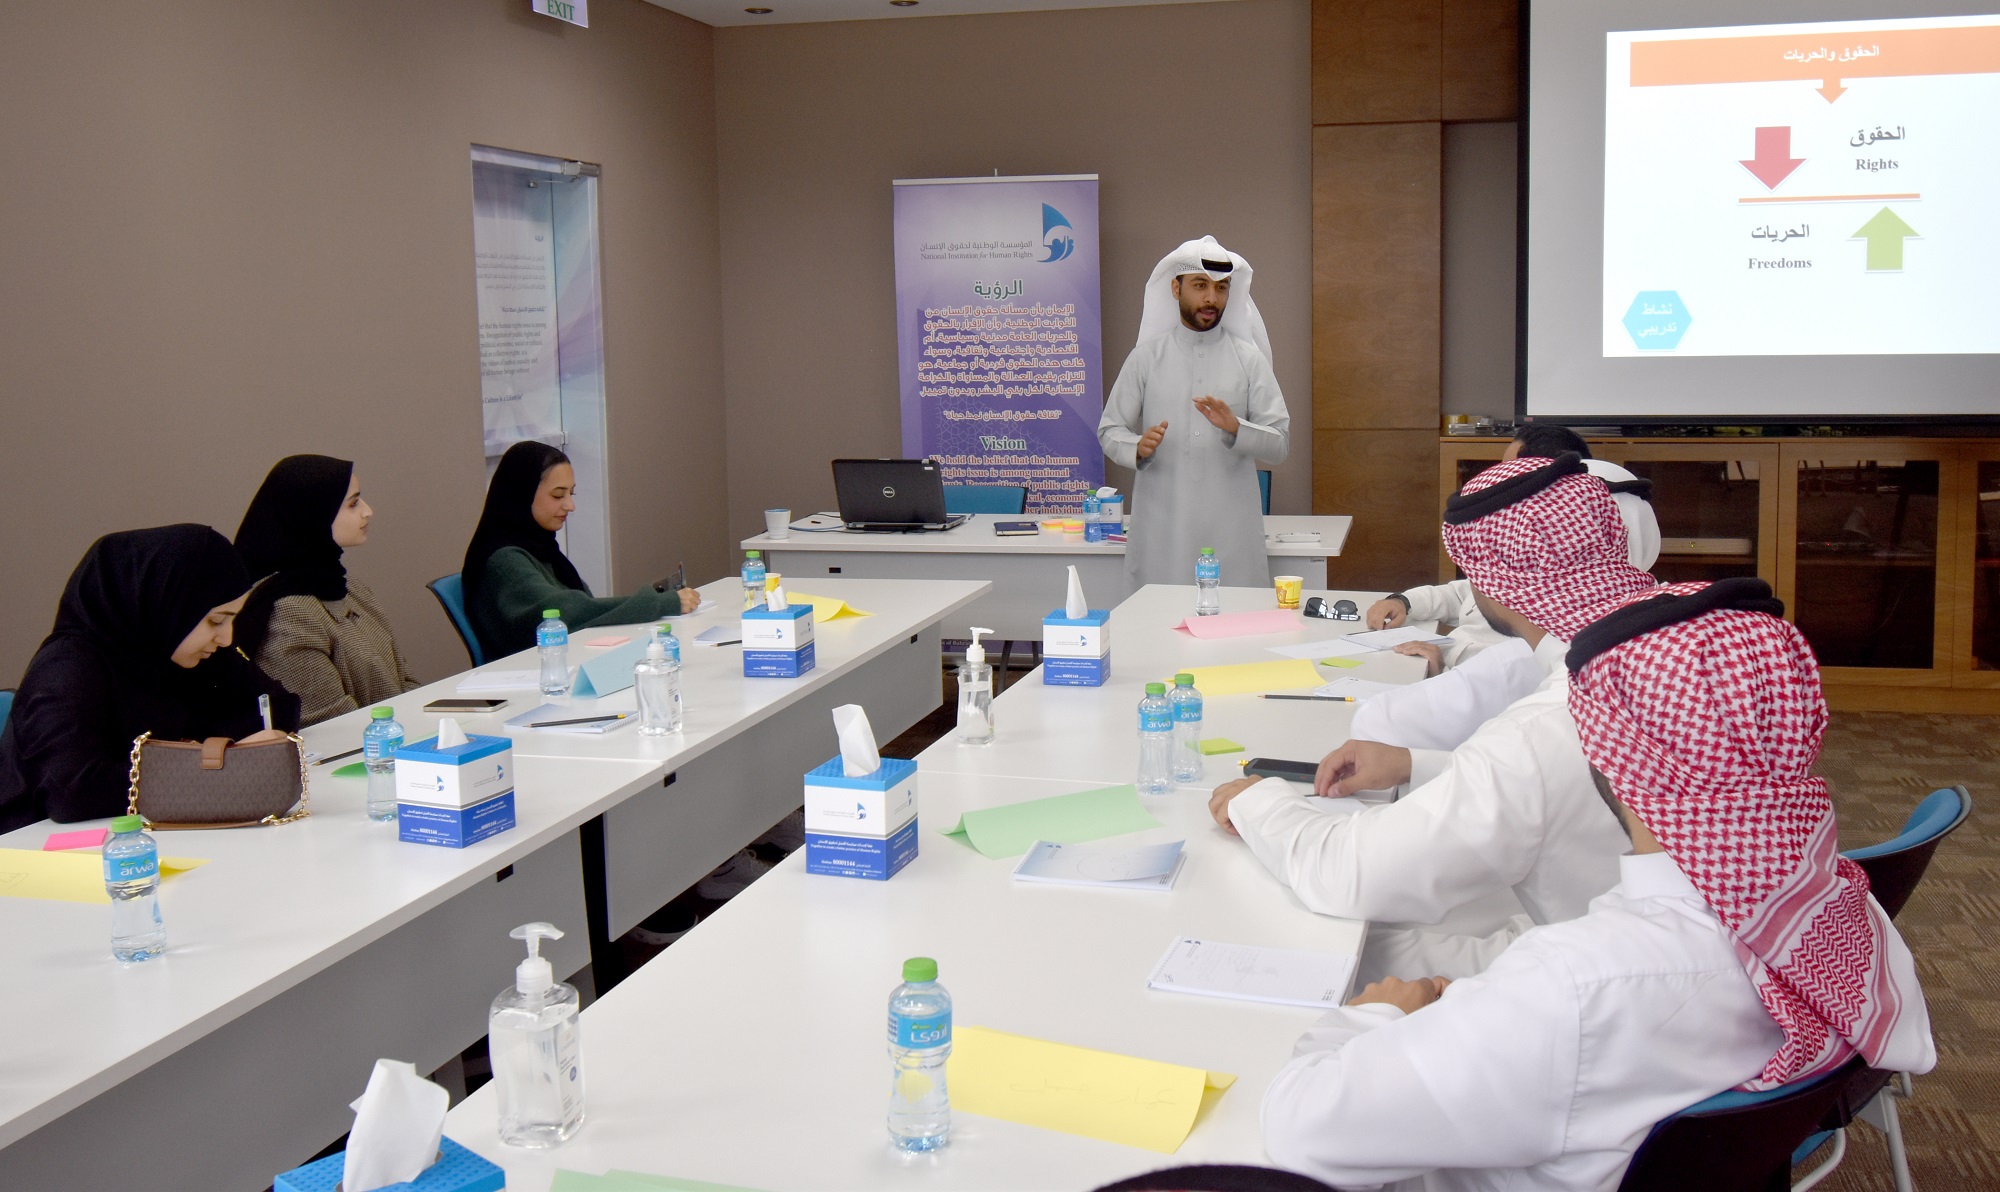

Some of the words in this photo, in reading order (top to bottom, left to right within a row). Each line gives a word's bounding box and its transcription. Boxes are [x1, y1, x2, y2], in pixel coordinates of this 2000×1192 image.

[548, 0, 574, 20] EXIT
[1783, 47, 1836, 64] والحريات
[1838, 45, 1880, 62] الحقوق
[1849, 126, 1906, 148] الحقوق
[1855, 157, 1899, 172] Rights
[1751, 224, 1810, 243] الحريات
[920, 242, 946, 252] الإنسان
[948, 242, 970, 252] لحقوق
[972, 241, 998, 250] الوطنية
[1000, 240, 1033, 250] المؤسسة
[978, 252, 988, 260] for
[1748, 257, 1812, 271] Freedoms
[974, 279, 1023, 300] الرؤية
[925, 309, 940, 318] من
[941, 305, 972, 318] الإنسان
[973, 307, 998, 317] حقوق
[1000, 304, 1028, 315] مسألة
[1030, 303, 1044, 316] بأن
[1046, 304, 1075, 316] الإيمان
[1641, 303, 1673, 317] نشاط
[924, 320, 960, 332] بالحقوق
[961, 319, 984, 330] الإقرار
[986, 316, 1001, 330] وأن
[1042, 316, 1076, 328] الثوابت
[1637, 321, 1677, 338] تدريبي
[923, 331, 935, 344] أم
[980, 334, 1007, 342] مدنية
[1009, 332, 1037, 341] العامة
[1038, 332, 1078, 343] والحريات
[924, 346, 952, 356] وسواء
[989, 345, 1035, 356] واجتماعية
[1036, 344, 1079, 355] اقتصادية
[918, 361, 934, 370] هو
[970, 356, 979, 371] أو
[979, 358, 1005, 368] فردية
[1006, 358, 1038, 369] الحقوق
[1040, 358, 1060, 368] هذه
[1062, 357, 1085, 368] كانت
[918, 372, 956, 383] والكرامة
[957, 372, 1000, 382] والمساواة
[1001, 371, 1032, 381] العدالة
[1034, 372, 1056, 382] بقيم
[1058, 370, 1085, 382] التزام
[948, 386, 976, 396] وبدون
[977, 385, 1003, 396] البشر
[1004, 386, 1023, 398] بني
[1024, 384, 1043, 396] لكل
[1044, 384, 1085, 396] الإنسانية
[965, 410, 982, 420] نمط
[984, 410, 1012, 421] الإنسان
[1013, 411, 1036, 421] حقوق
[979, 435, 1026, 451] Vision
[946, 455, 966, 465] hold
[968, 455, 981, 465] the
[983, 455, 1009, 465] belief
[1010, 455, 1029, 465] that
[1030, 455, 1046, 465] the
[1047, 455, 1080, 465] human
[940, 468, 966, 478] rights
[967, 468, 988, 477] issue
[990, 468, 999, 477] is
[1000, 469, 1030, 479] among
[1032, 468, 1070, 478] national
[1032, 480, 1060, 491] public
[1062, 480, 1090, 492] rights
[1024, 505, 1039, 514] her
[1041, 505, 1083, 514] individua
[120, 862, 154, 876] arwa
